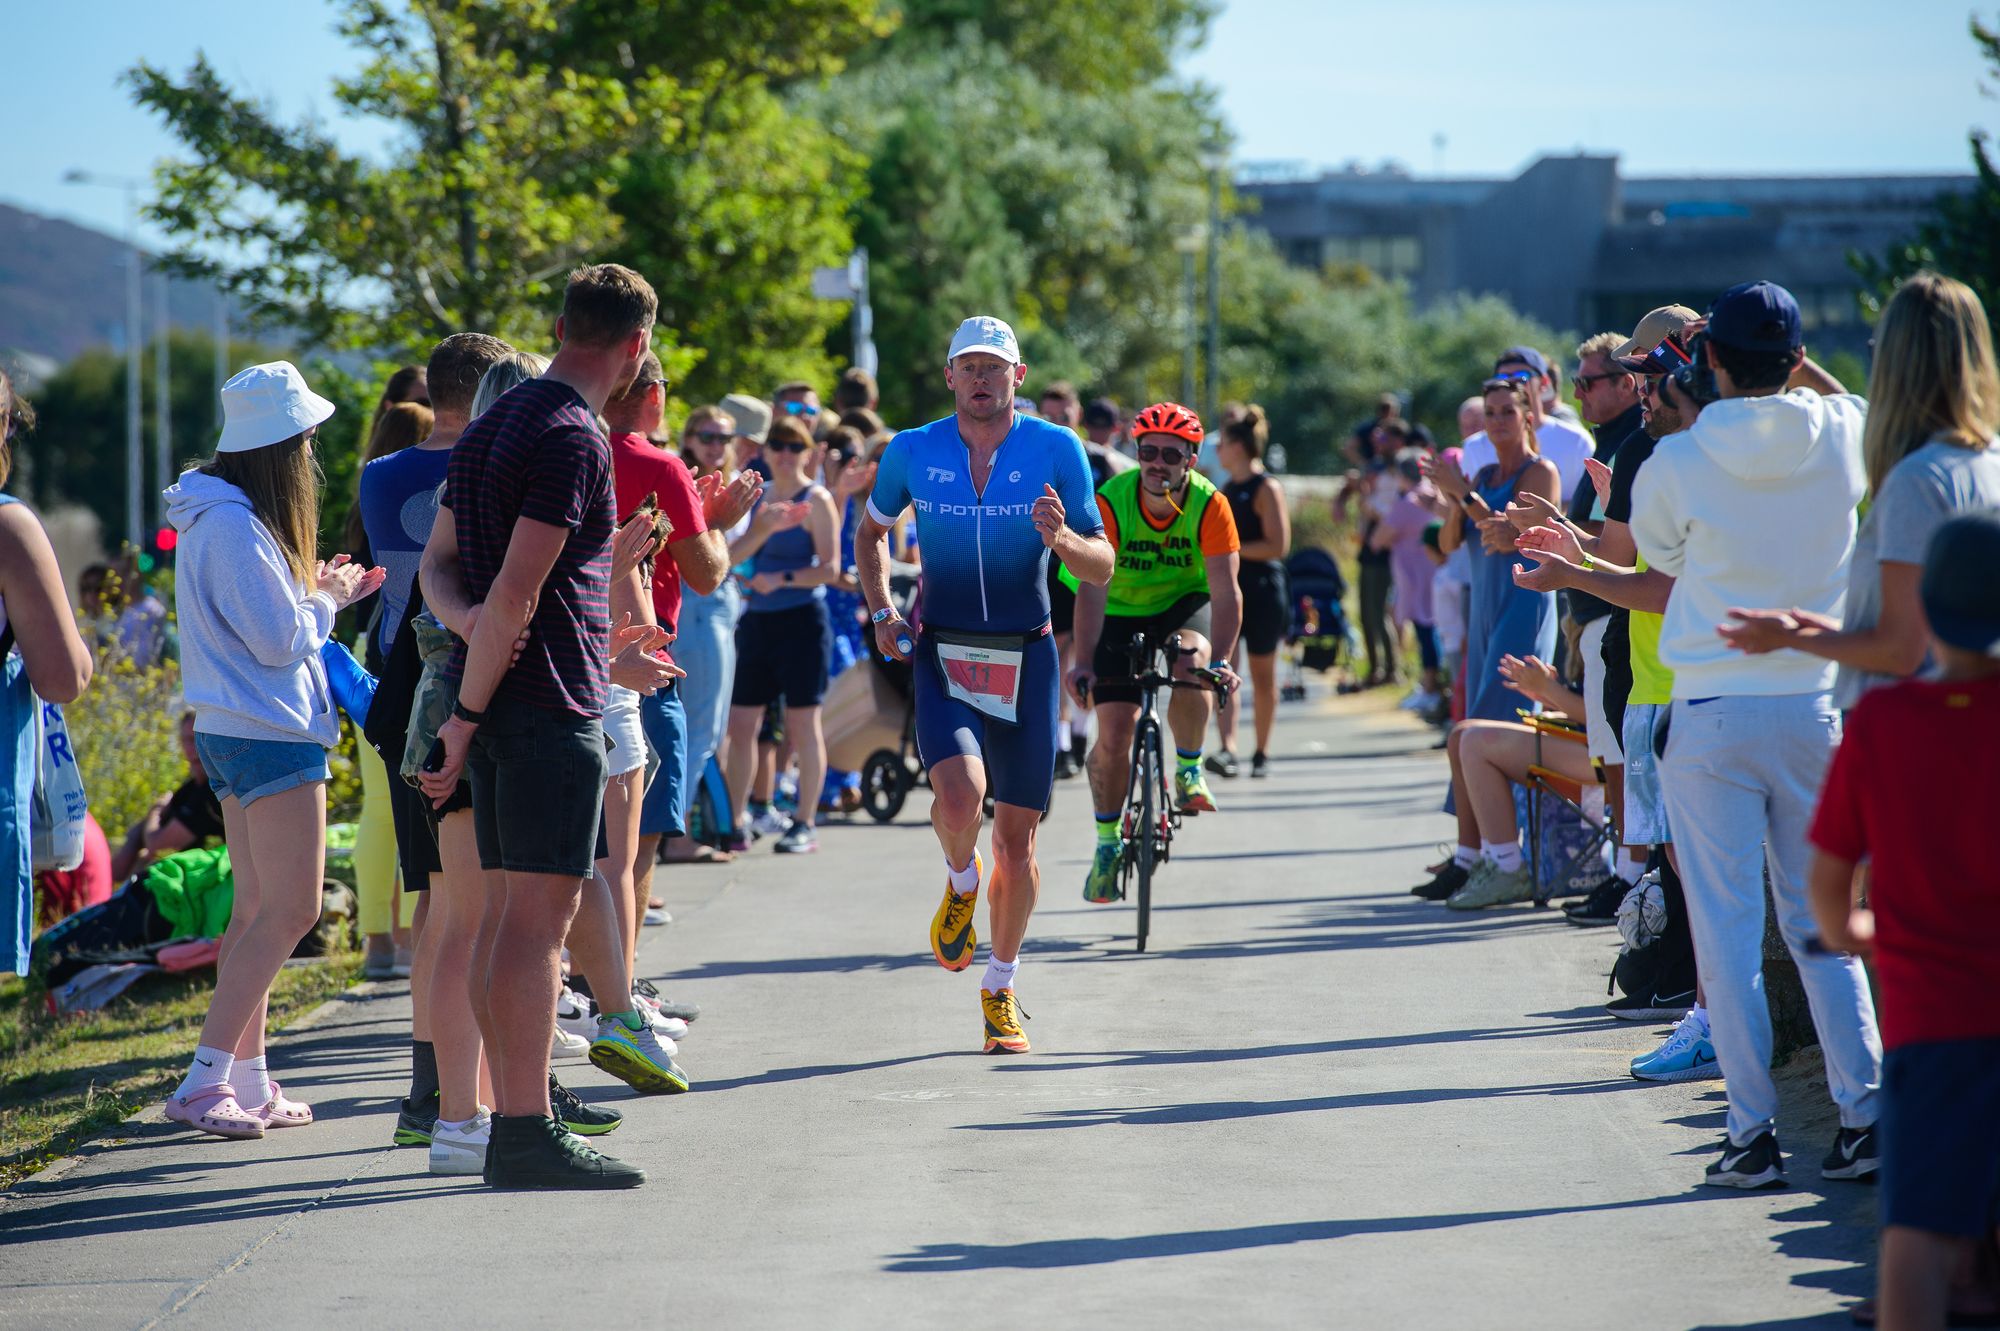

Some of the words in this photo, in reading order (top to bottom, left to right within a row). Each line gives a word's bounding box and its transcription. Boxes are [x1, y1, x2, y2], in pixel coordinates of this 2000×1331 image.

[926, 466, 956, 483] TP
[912, 498, 932, 513] TRI
[1119, 556, 1152, 570] 2ND
[967, 664, 992, 683] 11
[1568, 874, 1608, 889] adid
